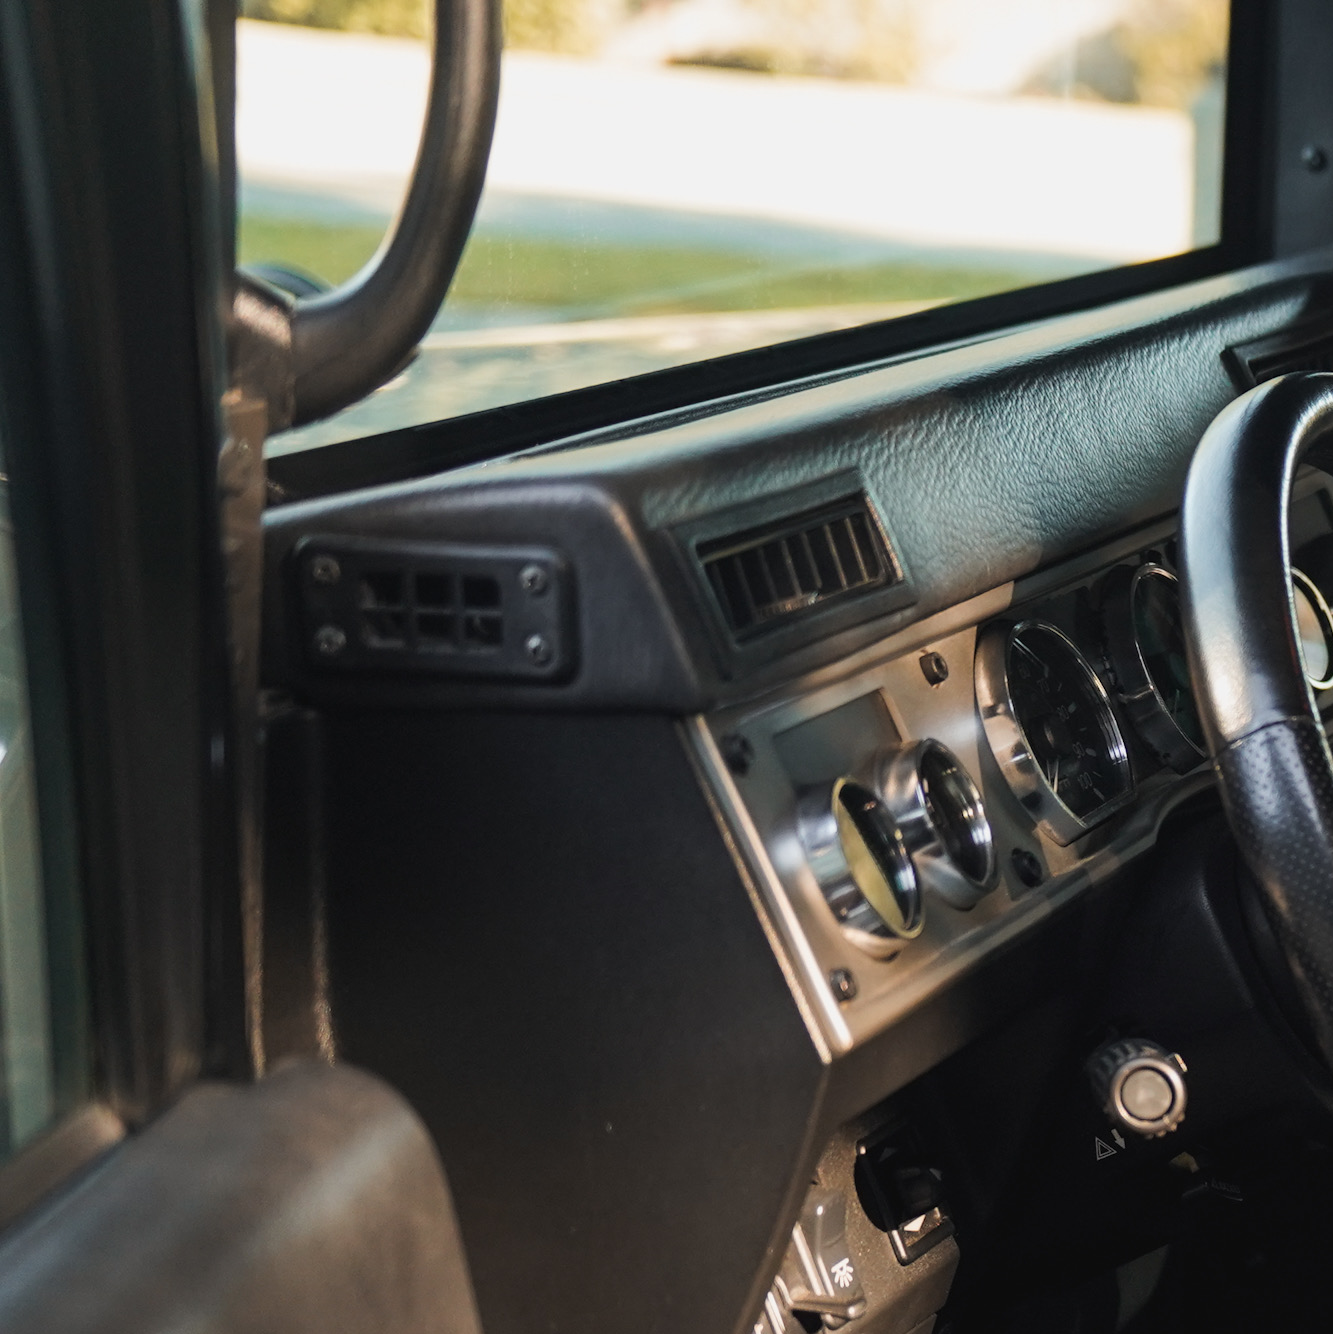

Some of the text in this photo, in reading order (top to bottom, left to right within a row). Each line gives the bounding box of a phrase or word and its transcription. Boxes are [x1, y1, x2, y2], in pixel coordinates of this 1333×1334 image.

[1056, 704, 1070, 722] 80
[1072, 742, 1086, 759] 90
[1077, 771, 1093, 791] 100
